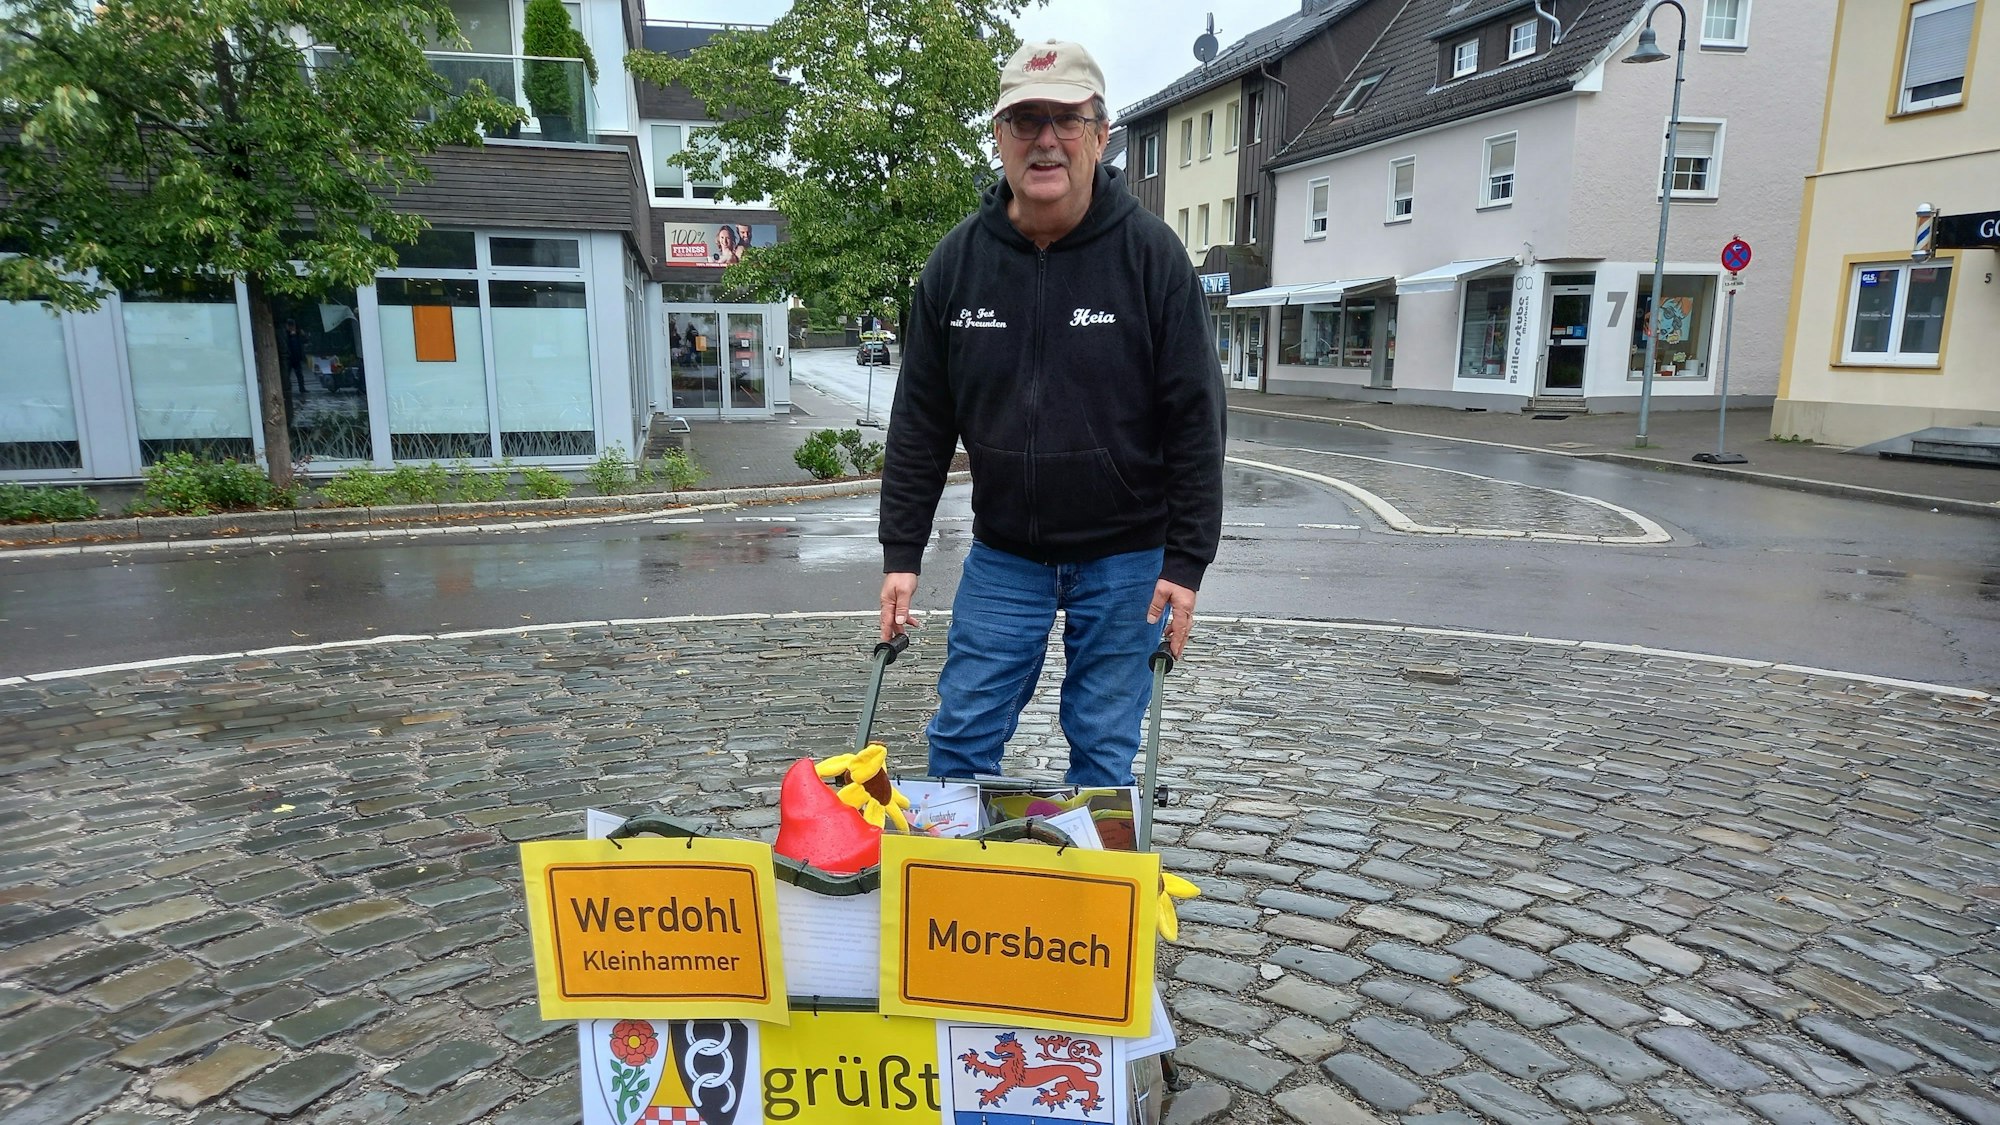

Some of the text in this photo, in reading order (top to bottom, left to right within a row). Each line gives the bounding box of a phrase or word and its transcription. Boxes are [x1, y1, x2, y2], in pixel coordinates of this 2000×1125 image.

[671, 229, 705, 246] 100%
[1862, 273, 1876, 282] GLS
[1984, 272, 1992, 284] 5
[976, 308, 995, 319] Fest
[1070, 308, 1116, 326] Heia
[1607, 292, 1628, 327] 7
[965, 317, 1008, 329] Freunden
[1510, 296, 1525, 384] Brillenstube
[570, 896, 742, 934] Werdohl
[928, 918, 1111, 968] Morsbach
[583, 950, 740, 972] Kleinhammer
[764, 1055, 941, 1121] grüßt
